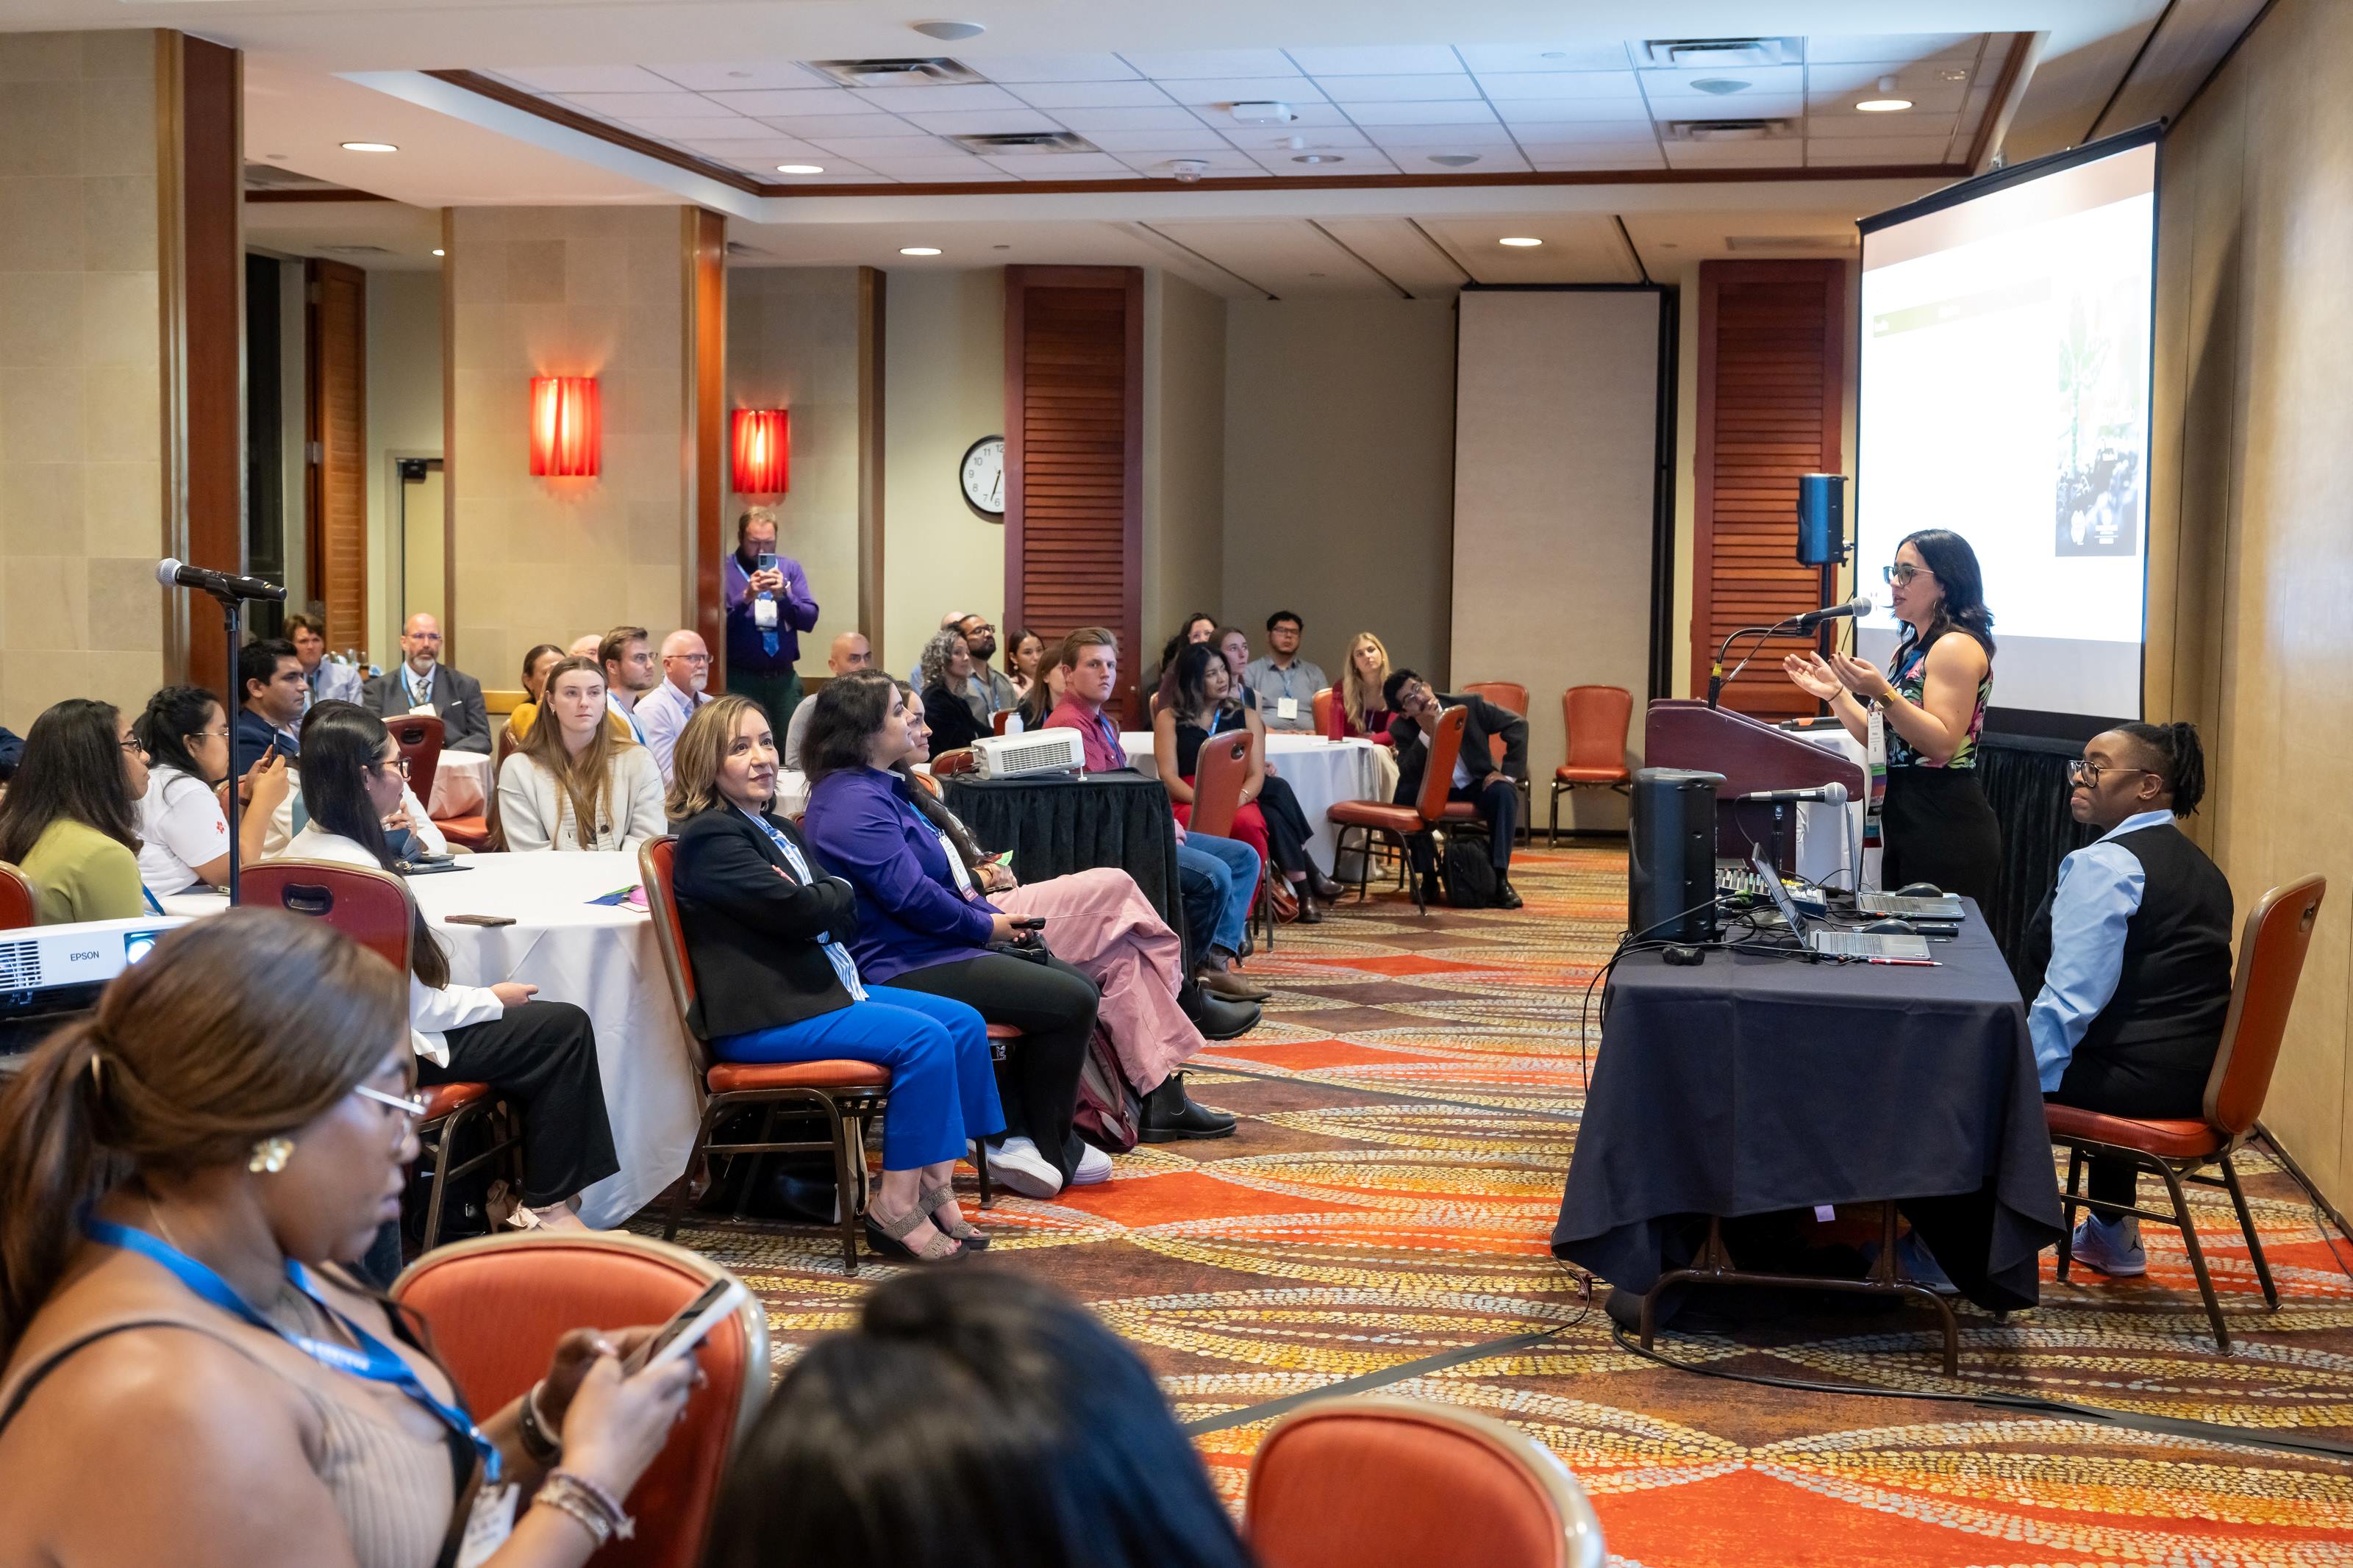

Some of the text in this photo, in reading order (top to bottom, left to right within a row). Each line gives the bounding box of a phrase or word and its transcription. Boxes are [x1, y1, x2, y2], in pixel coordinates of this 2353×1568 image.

[974, 457, 982, 465] 10
[968, 470, 974, 479] 9
[972, 484, 978, 492] 8
[983, 494, 988, 502] 7
[994, 498, 1000, 506] 6
[70, 951, 99, 962] EPSON
